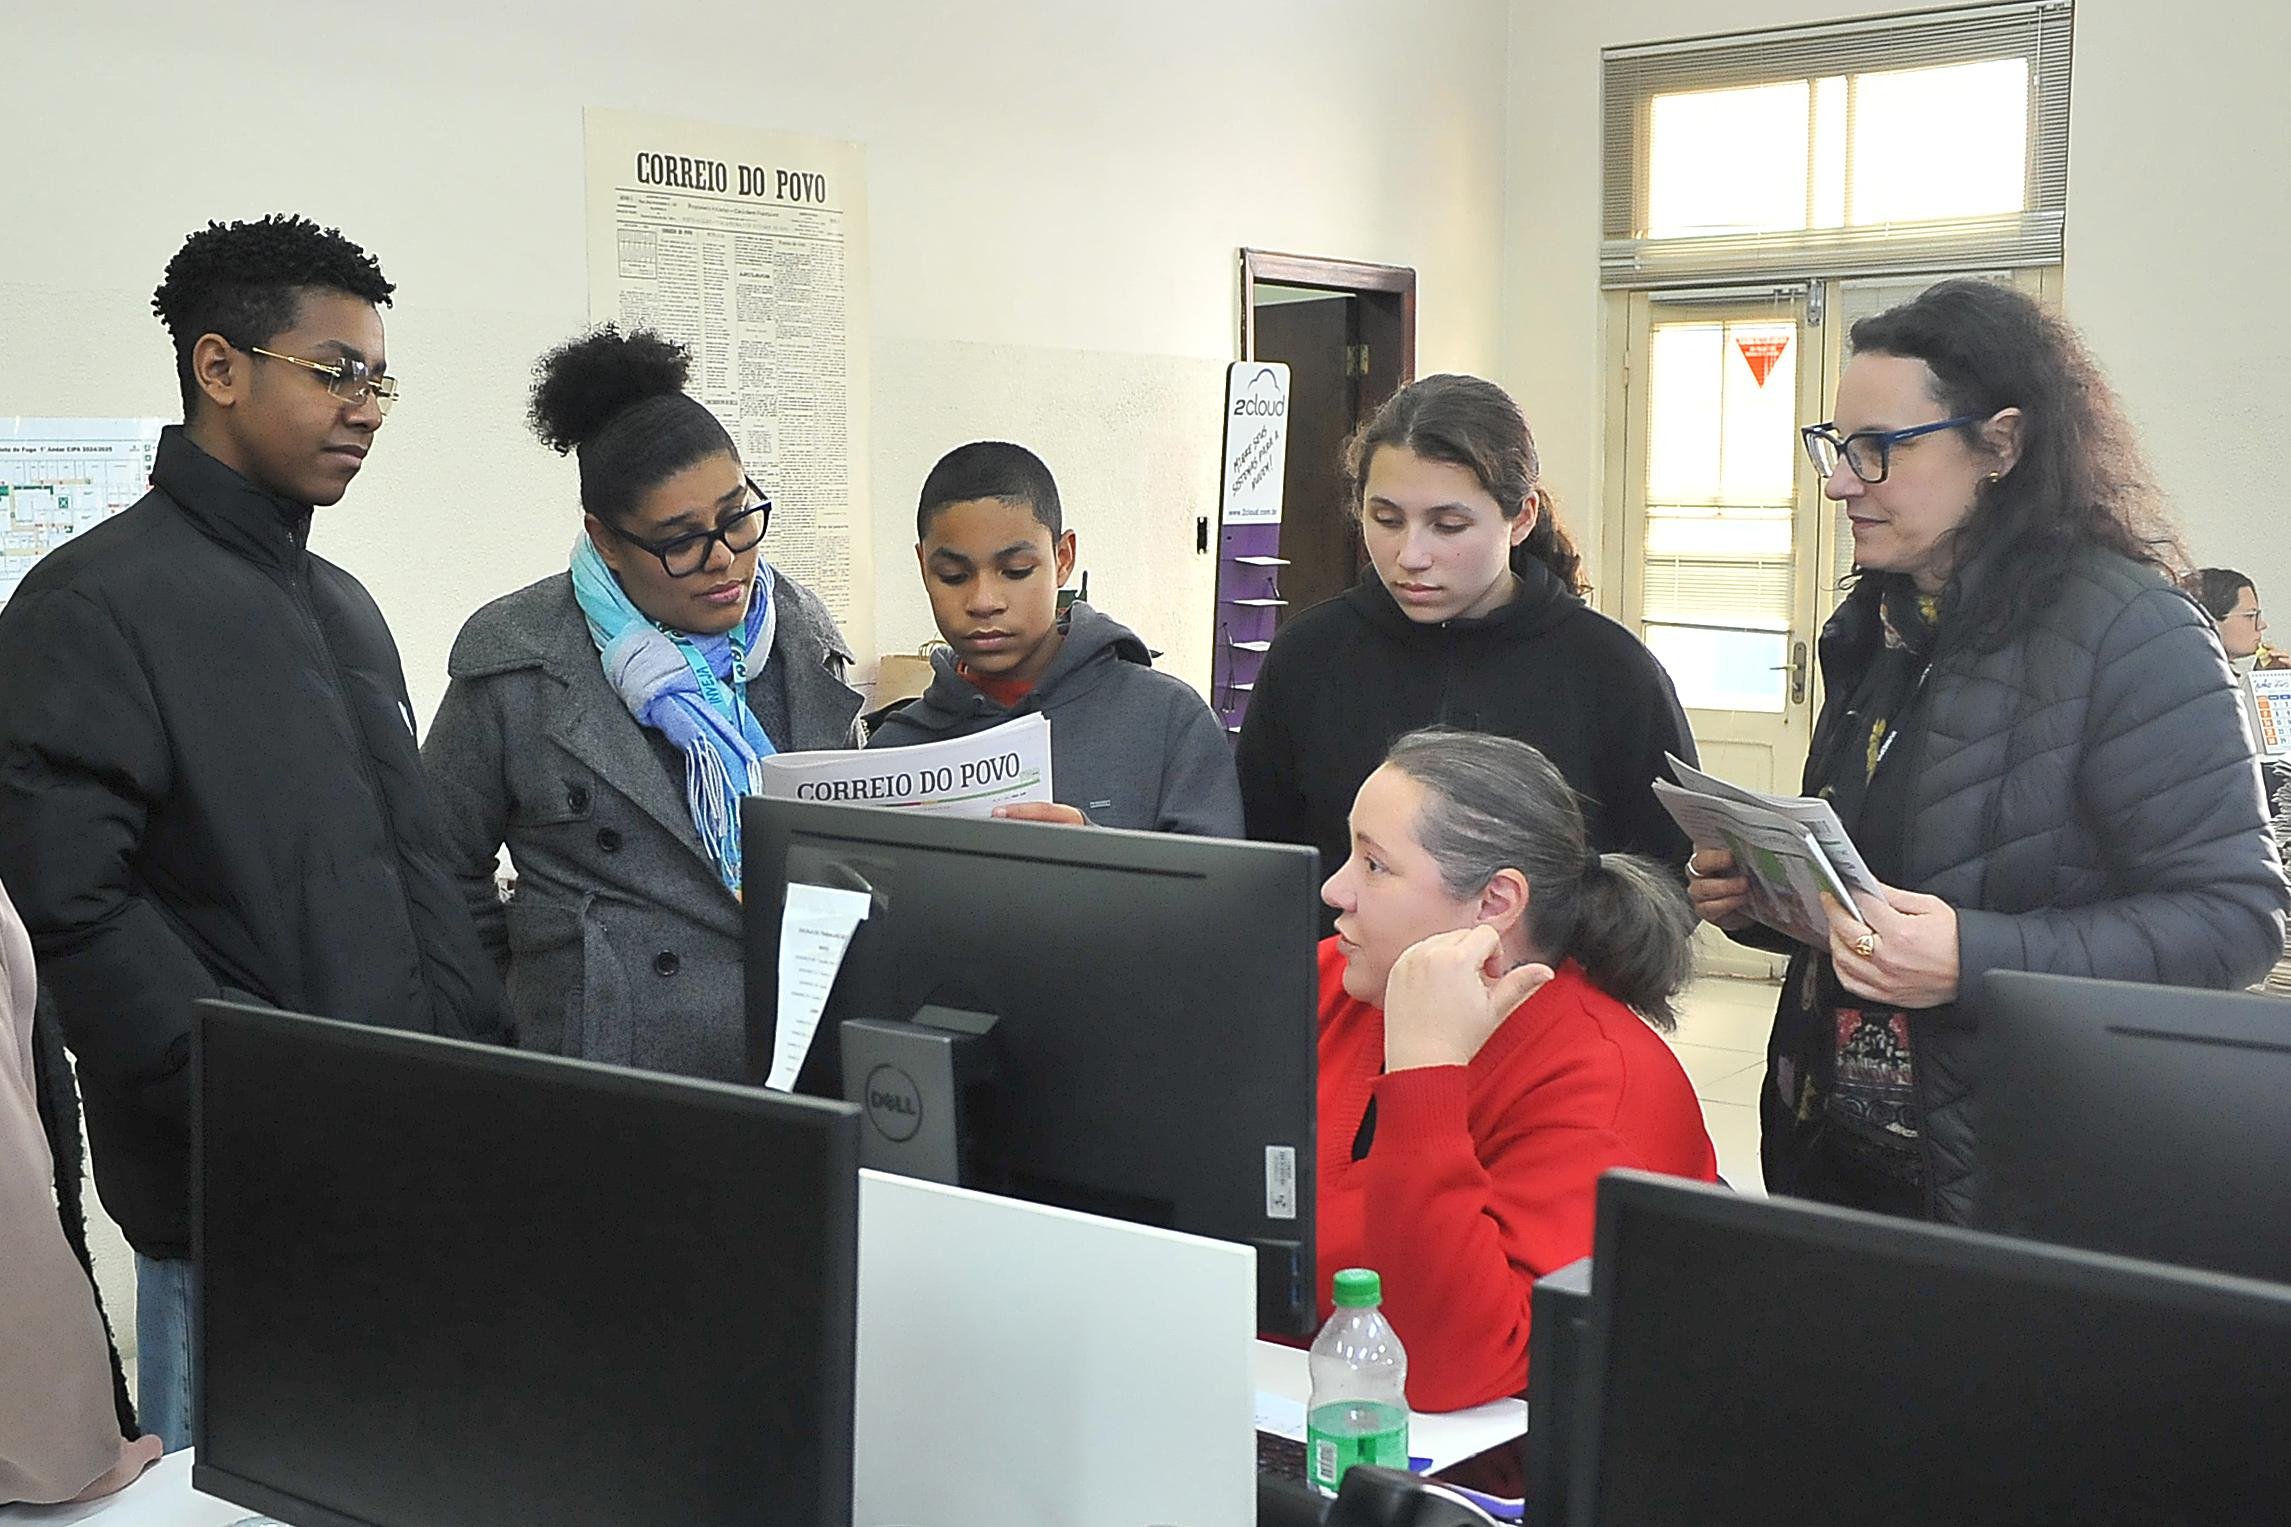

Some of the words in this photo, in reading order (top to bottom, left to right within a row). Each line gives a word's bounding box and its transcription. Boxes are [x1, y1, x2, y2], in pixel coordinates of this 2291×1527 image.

[637, 152, 728, 193] CORREIO
[738, 164, 765, 197] DO
[776, 169, 826, 204] POVO
[1233, 393, 1286, 417] 2cloud
[797, 773, 912, 801] CORREIO
[920, 767, 952, 795] DO
[960, 752, 1020, 789] POVO
[871, 1091, 917, 1116] DELL
